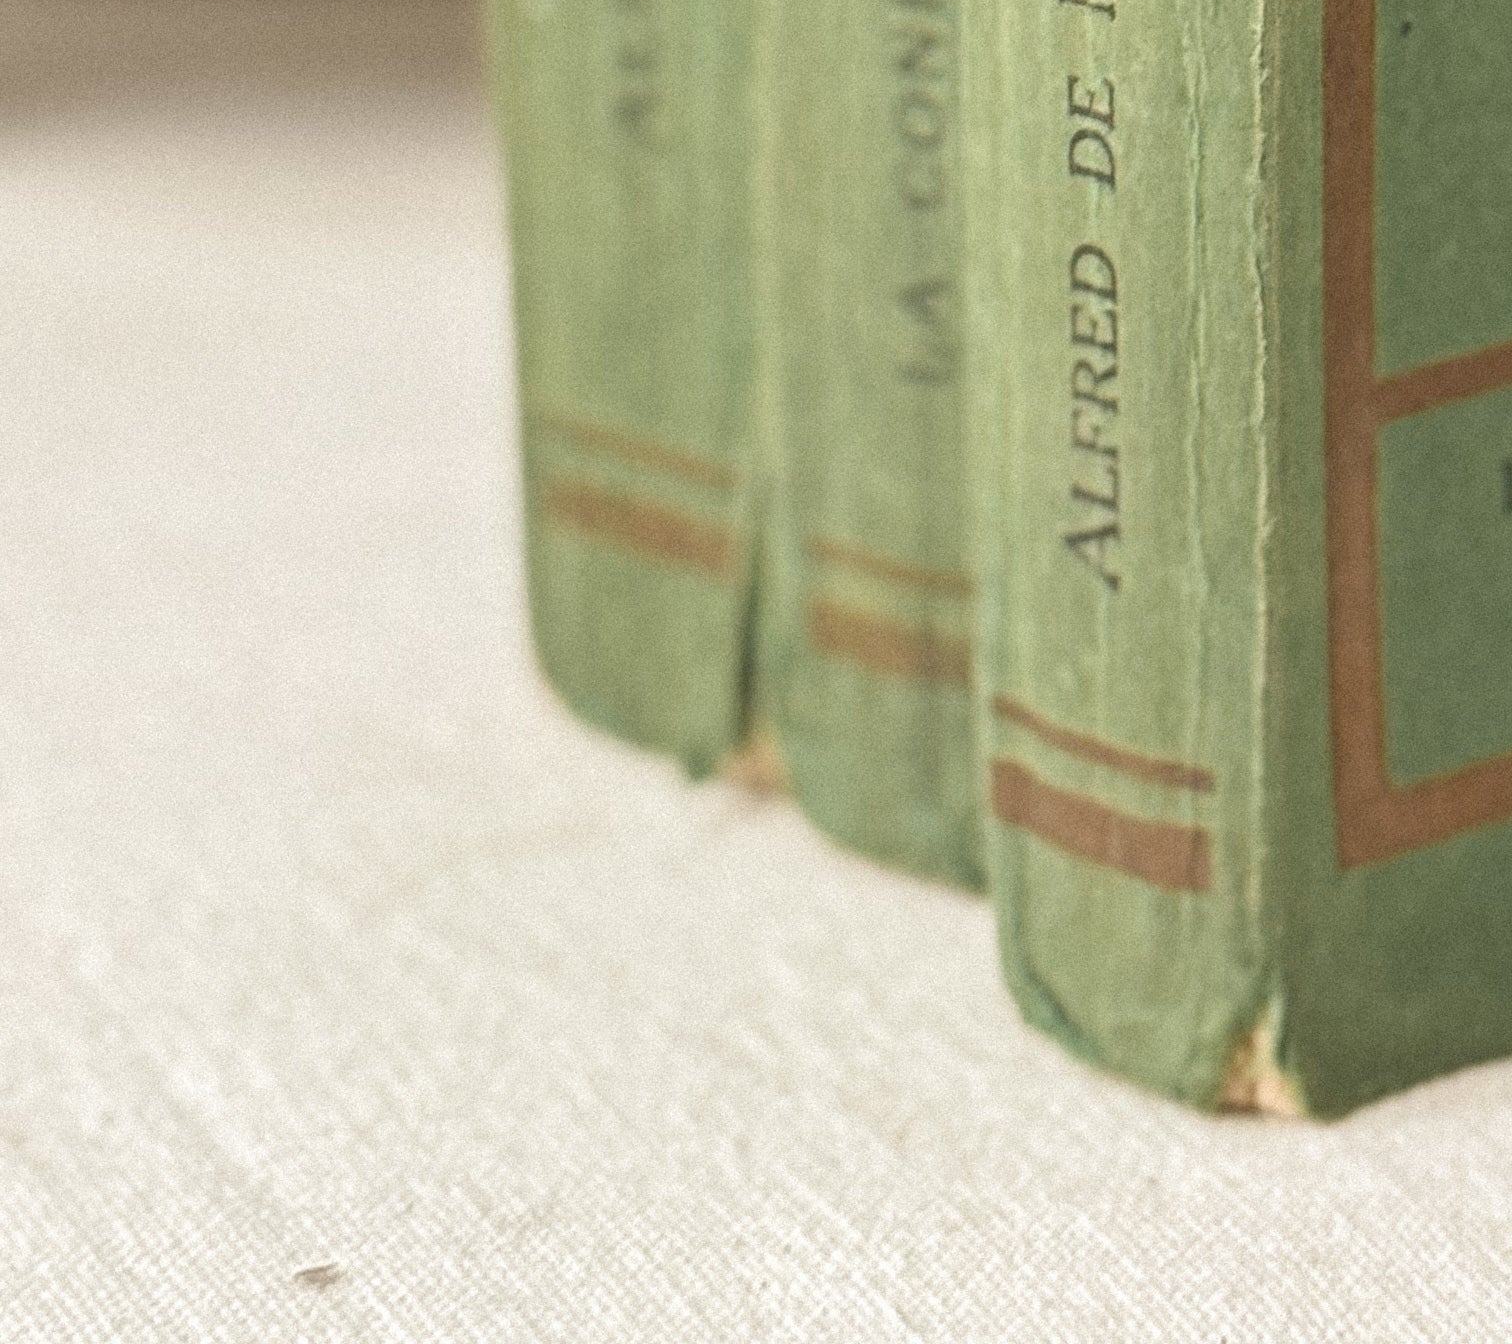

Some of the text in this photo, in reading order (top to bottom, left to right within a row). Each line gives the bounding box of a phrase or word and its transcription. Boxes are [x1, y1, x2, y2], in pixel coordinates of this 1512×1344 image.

[1068, 75, 1117, 191] DE
[898, 274, 958, 390] LA
[1064, 243, 1122, 592] ALFRED
